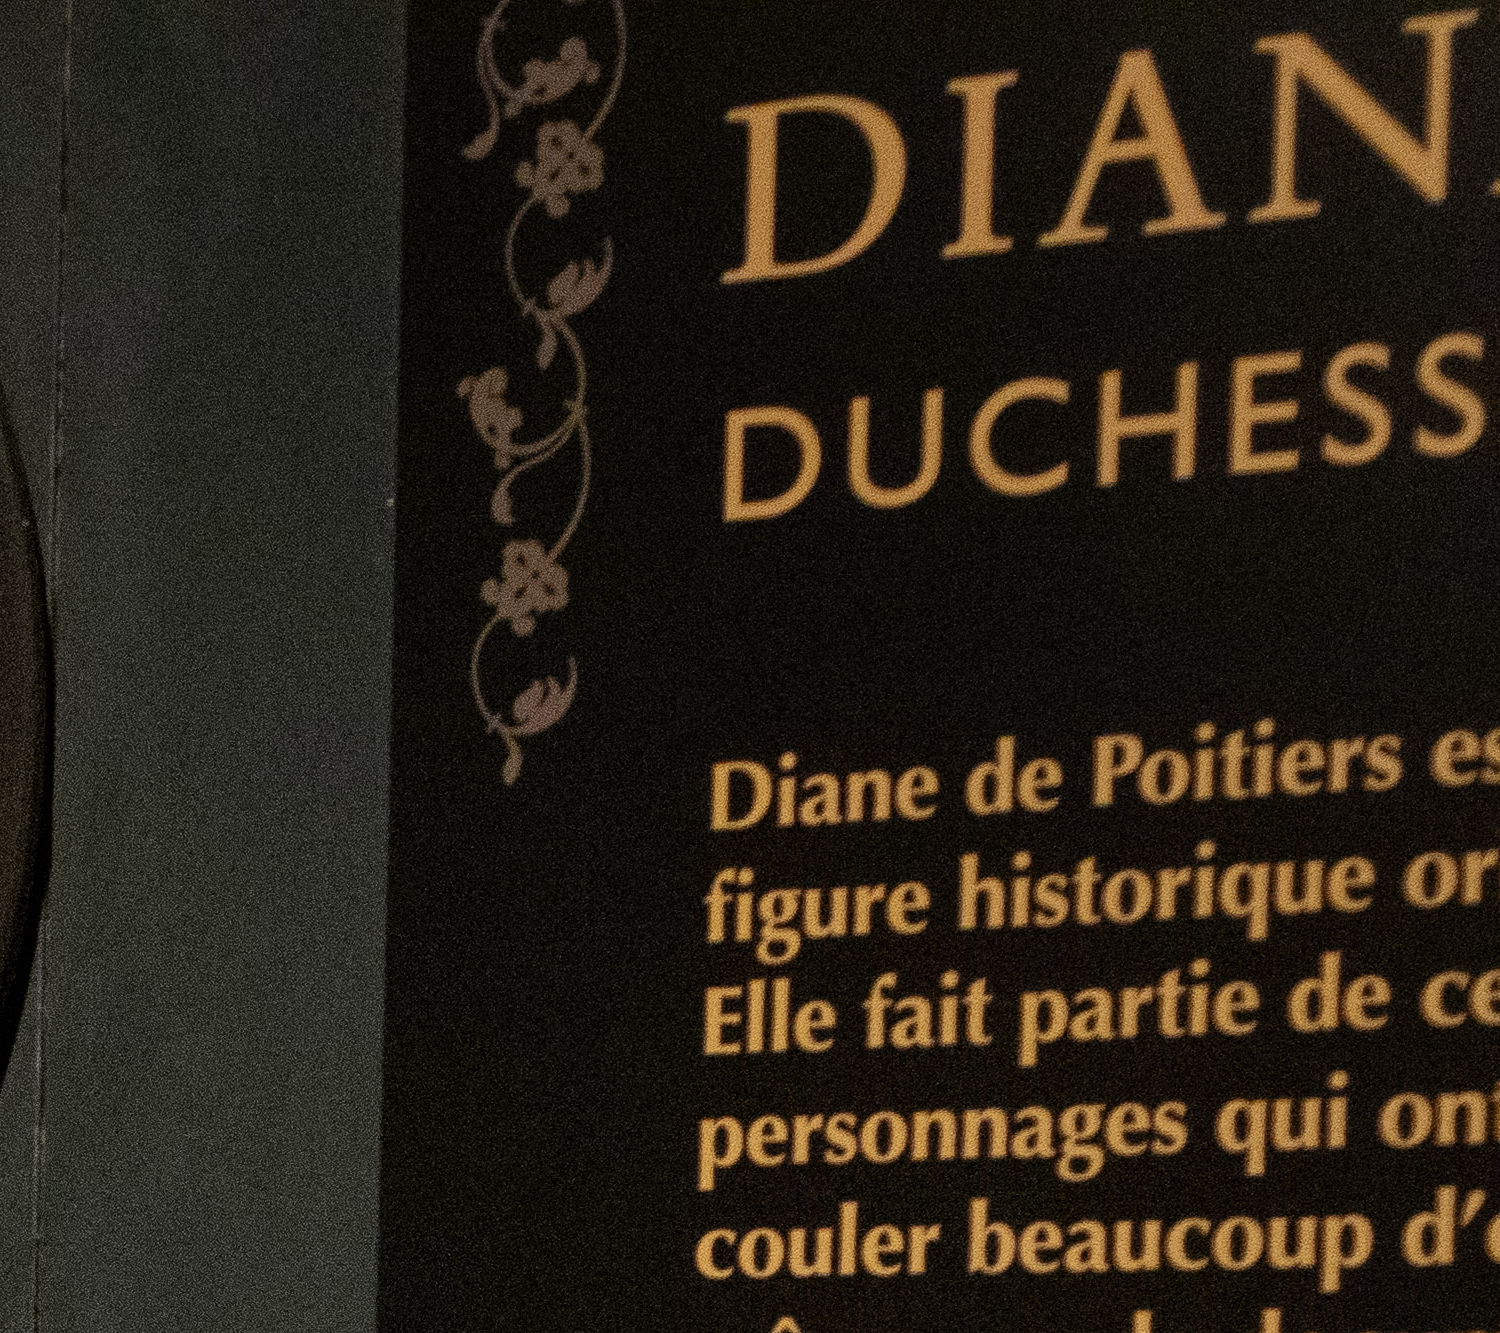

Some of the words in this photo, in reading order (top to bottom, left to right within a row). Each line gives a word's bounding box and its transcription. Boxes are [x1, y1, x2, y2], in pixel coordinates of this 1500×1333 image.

[722, 10, 1500, 283] DIAN
[724, 333, 1485, 521] DUCHESS
[711, 752, 938, 830] Diane
[967, 737, 1062, 814] de
[1094, 719, 1401, 805] Poitiers
[705, 868, 930, 964] figure
[959, 841, 1374, 940] historique
[704, 978, 836, 1055] Elle
[864, 970, 992, 1048] fait
[1019, 959, 1259, 1067] partie
[1289, 952, 1390, 1031] de
[698, 1102, 1187, 1191] personnages
[1217, 1071, 1348, 1176] qui
[695, 1201, 940, 1279] couler
[968, 1198, 1373, 1292] beaucoup
